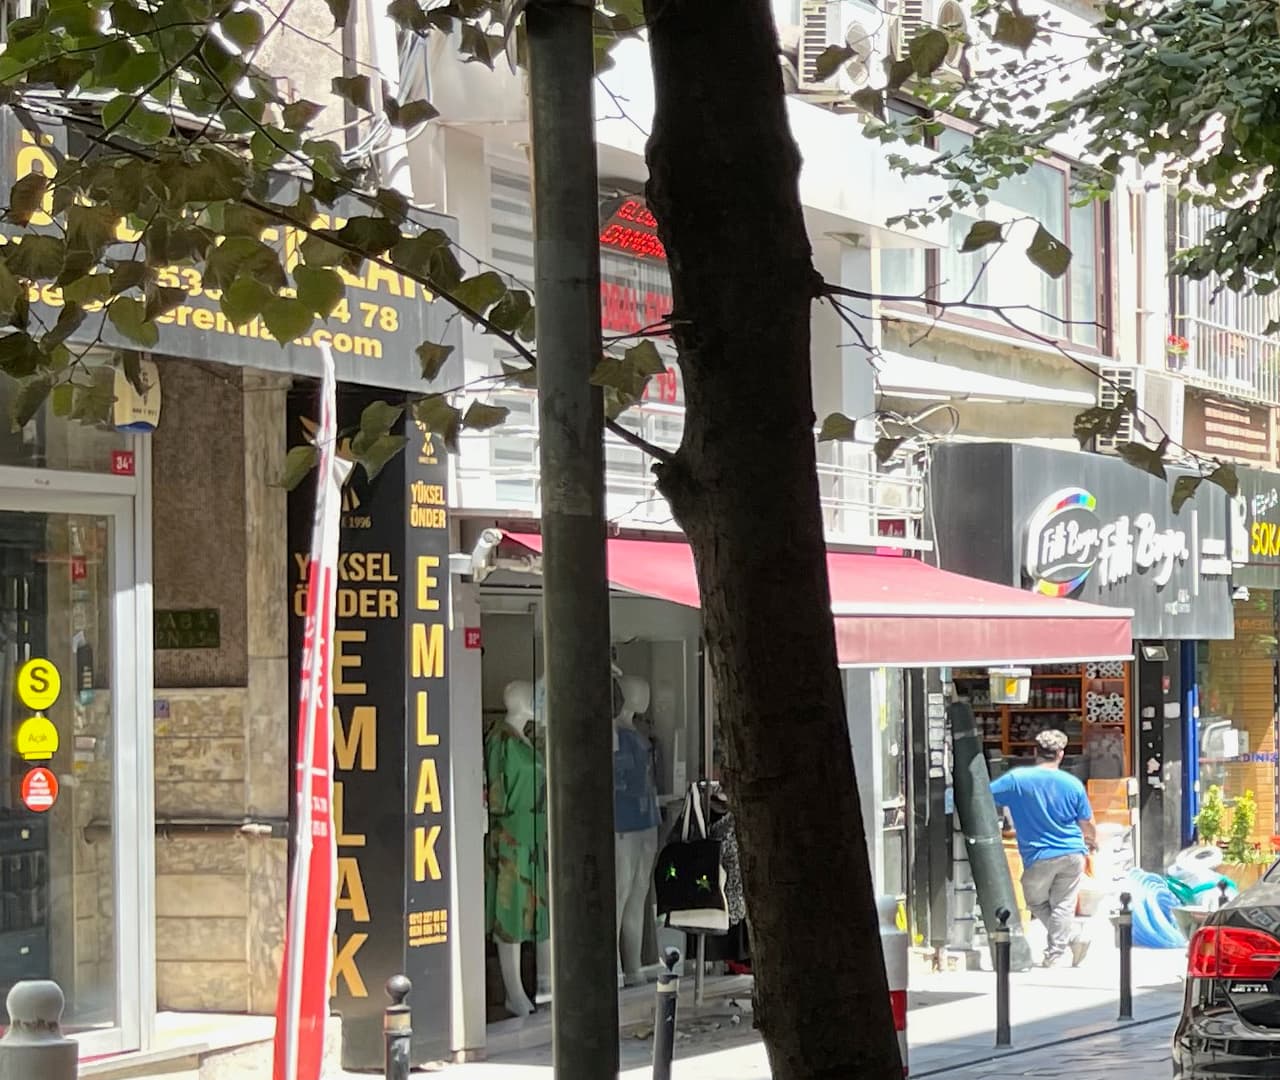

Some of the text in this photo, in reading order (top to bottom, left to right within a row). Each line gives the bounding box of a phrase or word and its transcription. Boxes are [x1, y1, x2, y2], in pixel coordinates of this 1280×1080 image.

[360, 302, 399, 332] 78
[410, 480, 446, 505] YÜKSEL
[410, 505, 446, 529] ÖNDER
[294, 552, 399, 582] YKSEL
[294, 583, 399, 618] ÖDER
[30, 666, 50, 693] S
[412, 555, 445, 882] EMLAK
